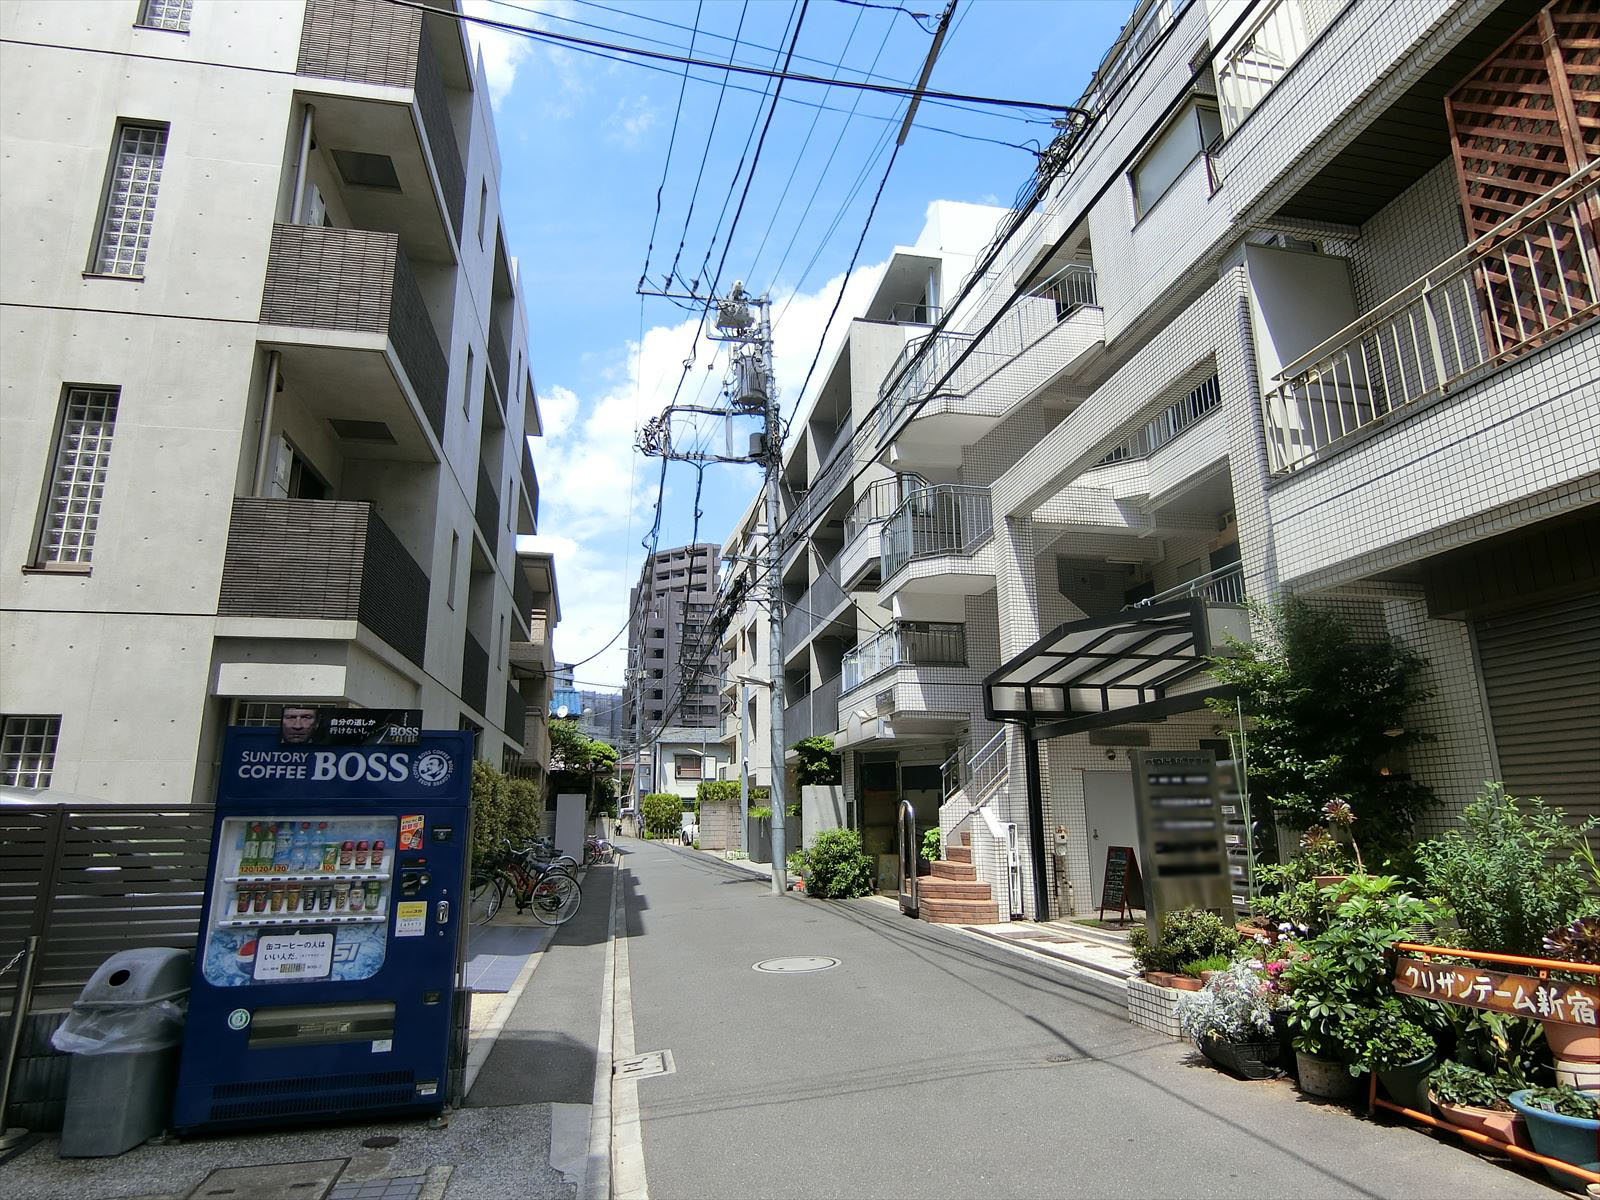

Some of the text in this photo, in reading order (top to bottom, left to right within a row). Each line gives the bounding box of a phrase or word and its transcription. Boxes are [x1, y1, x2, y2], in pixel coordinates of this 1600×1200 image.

[330, 717, 376, 727] 自分の道しか
[390, 726, 419, 737] BOSS
[242, 750, 309, 764] SUNTORY
[238, 752, 409, 782] COFFEE BOSS
[265, 941, 325, 951] 缶コーヒーの人は
[1405, 965, 1597, 1025] クリザンテーム新宿
